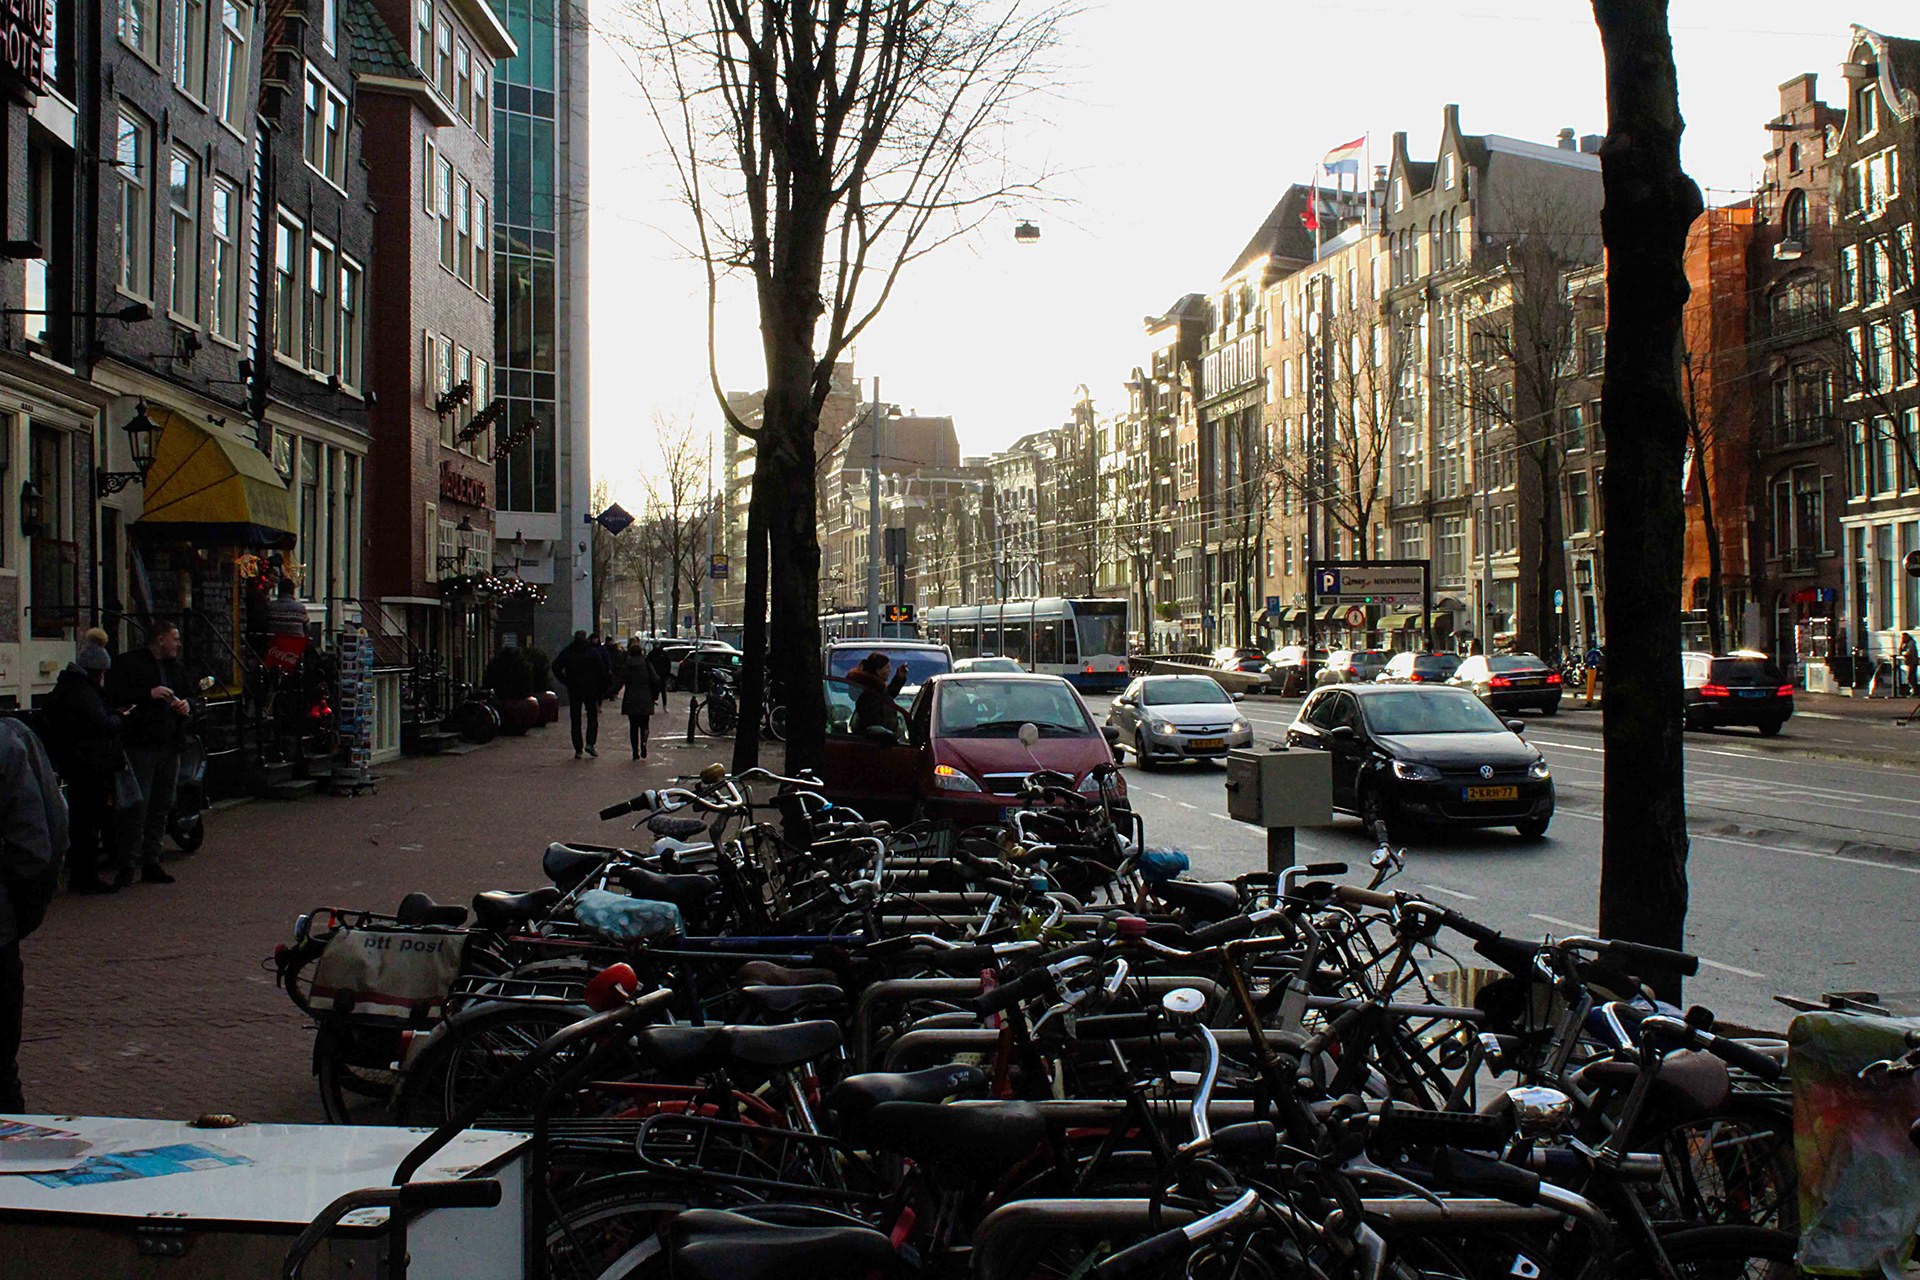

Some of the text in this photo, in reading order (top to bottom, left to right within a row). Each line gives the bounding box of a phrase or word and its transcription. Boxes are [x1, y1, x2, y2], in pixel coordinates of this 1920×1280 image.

[1323, 574, 1335, 592] P
[1470, 787, 1513, 798] 2-KRH-77
[363, 935, 446, 953] ptt post
